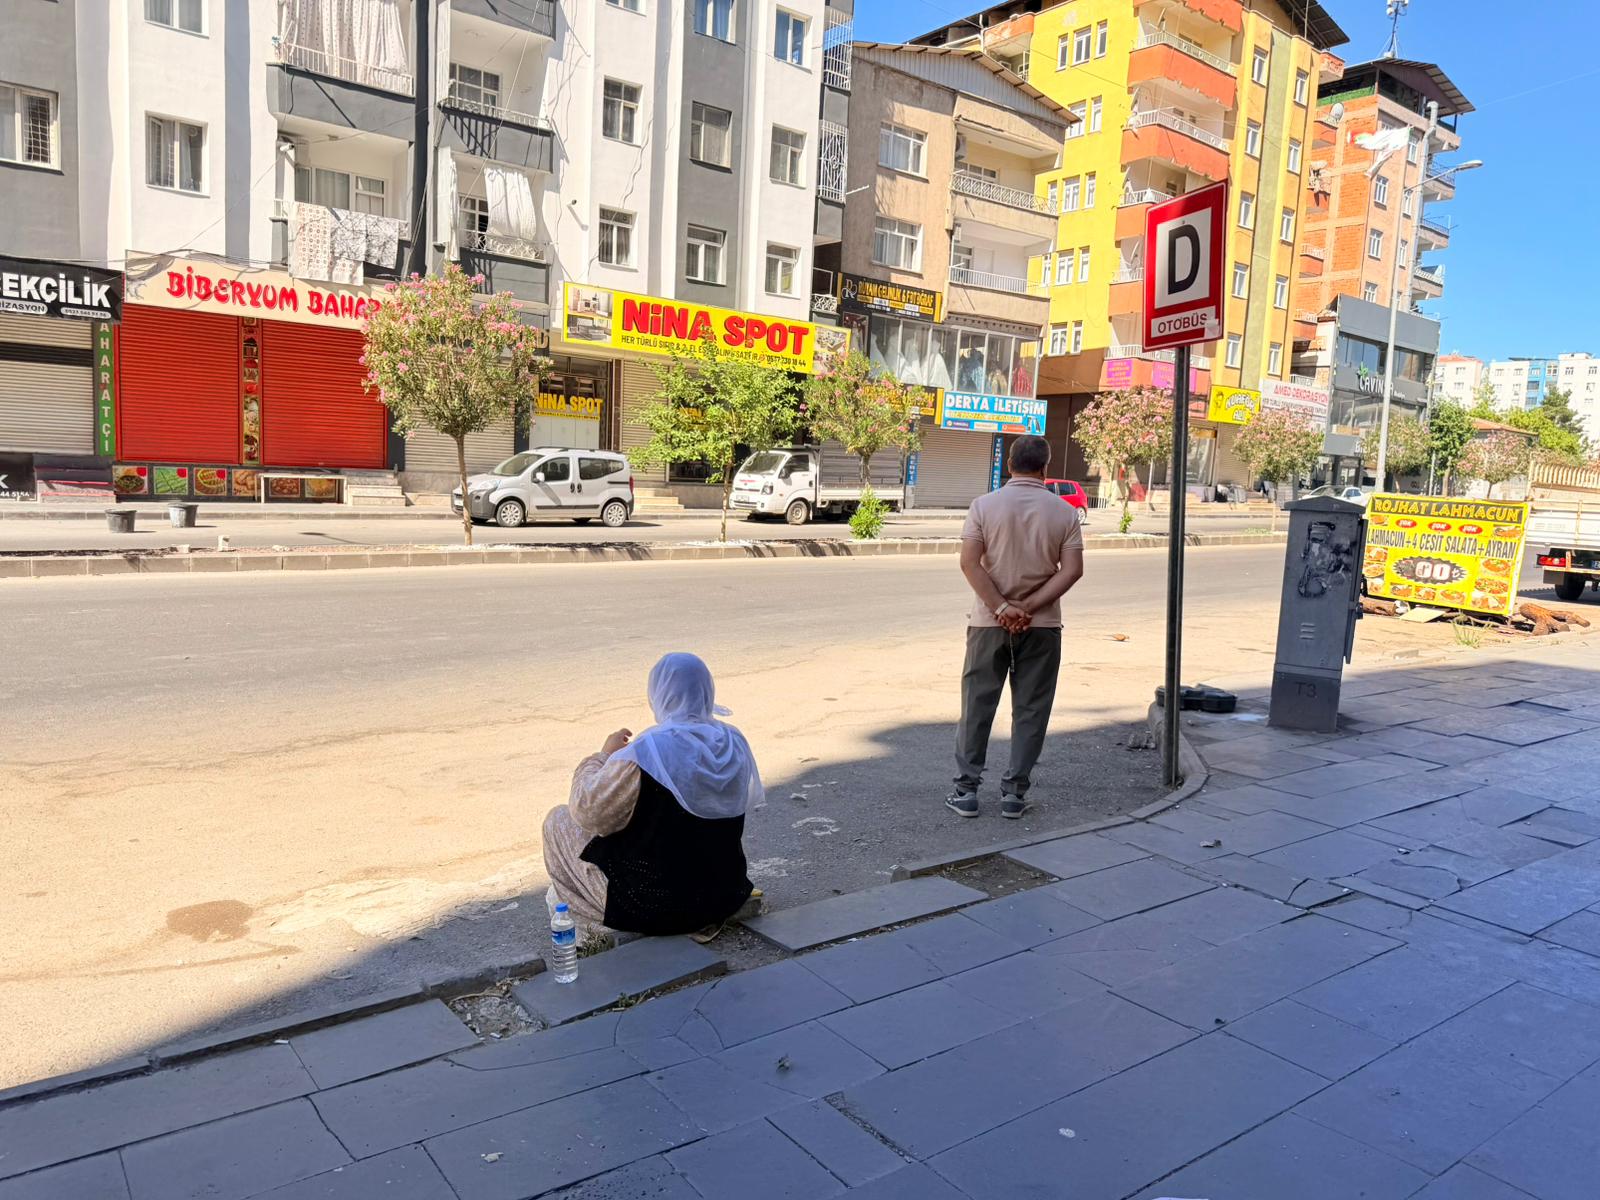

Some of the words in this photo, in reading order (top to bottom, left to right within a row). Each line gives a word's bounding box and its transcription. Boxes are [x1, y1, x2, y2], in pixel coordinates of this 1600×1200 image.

[1168, 224, 1200, 295] D
[0, 272, 111, 308] EKÇİLİK
[166, 266, 299, 313] BİBERYUM
[723, 315, 809, 356] SPOT
[1158, 312, 1207, 334] OTOBÜS
[621, 335, 635, 345] HER
[100, 323, 111, 452] AHARATÇI
[570, 395, 603, 415] SPOT
[945, 394, 989, 411] DERYA
[994, 397, 1045, 417] İLETİŞİM
[1374, 500, 1427, 516] ROJHAT
[1430, 504, 1520, 522] LAHMACUN
[1367, 528, 1406, 548] LAHMACUN
[1445, 535, 1477, 556] SALATA
[1485, 540, 1517, 559] AYRAN
